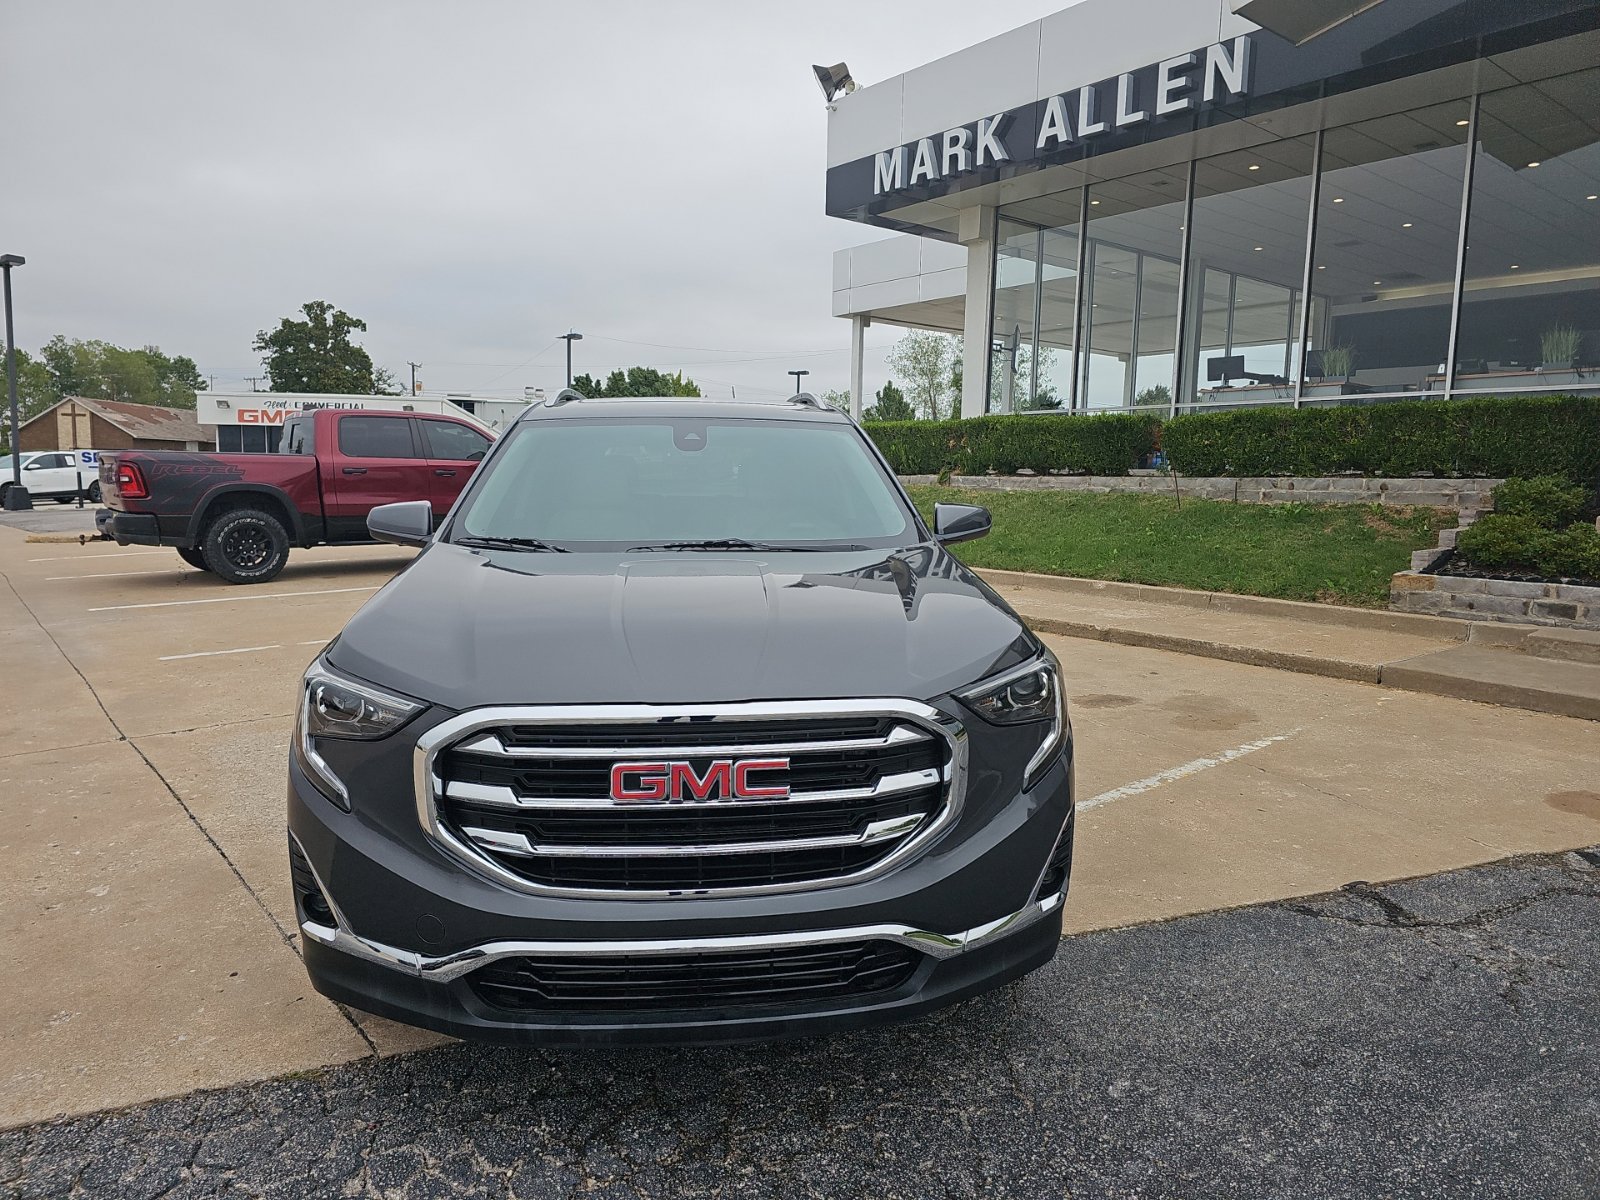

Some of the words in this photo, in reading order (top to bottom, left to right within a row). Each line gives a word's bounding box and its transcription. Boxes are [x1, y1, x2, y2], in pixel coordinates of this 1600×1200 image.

[874, 113, 1010, 195] MARK
[1036, 35, 1251, 149] ALLEN
[152, 463, 247, 476] REBEL
[610, 757, 791, 802] GMC
